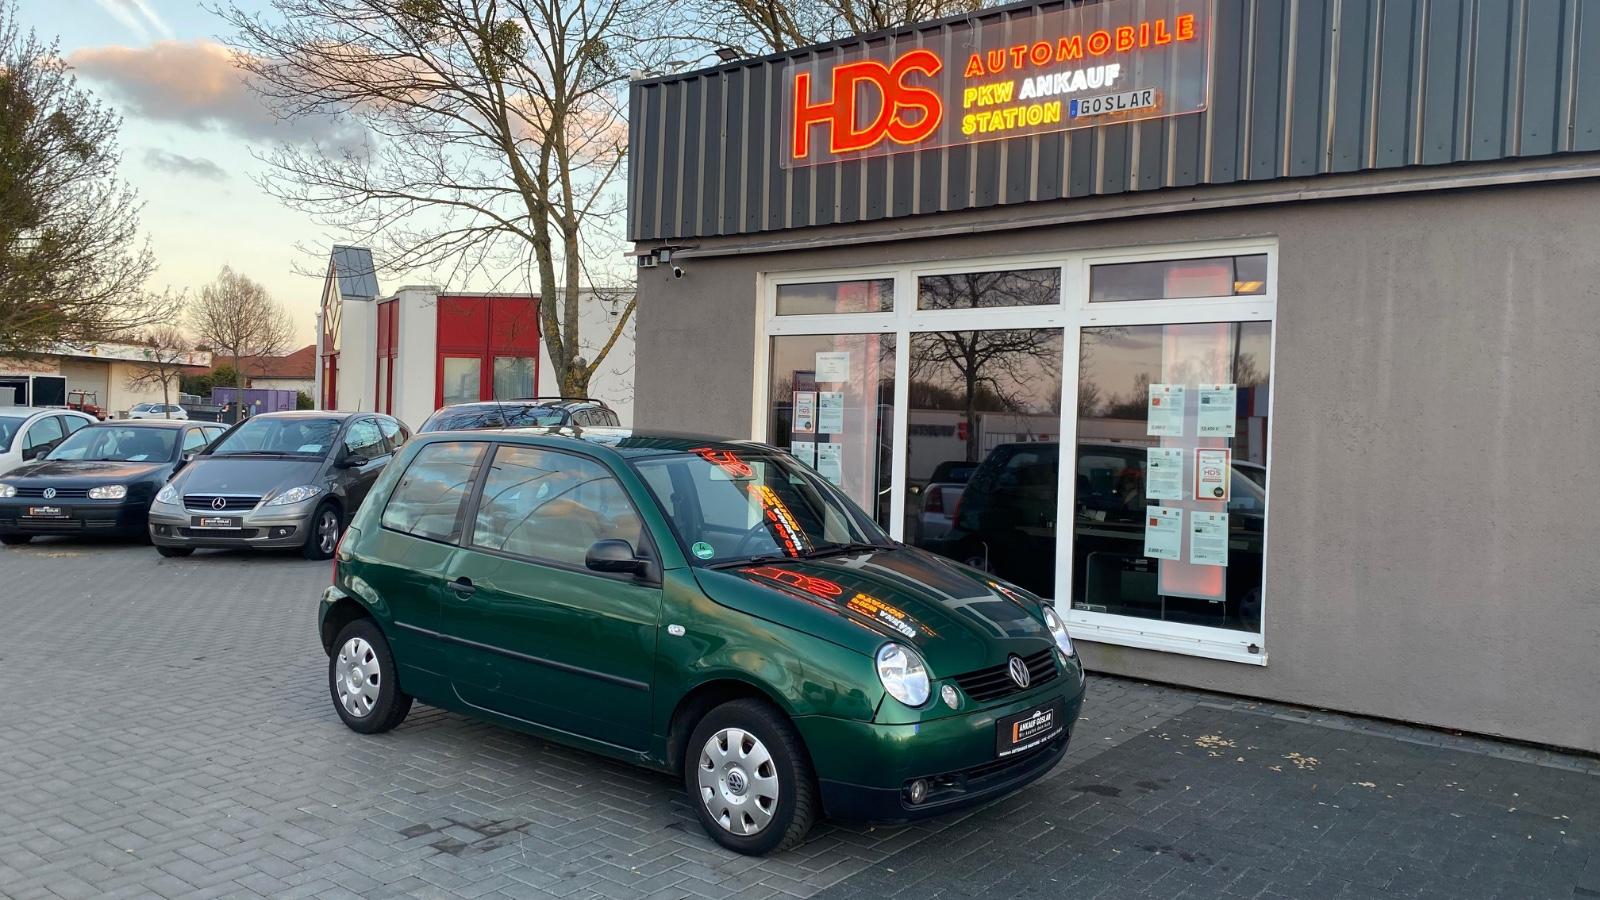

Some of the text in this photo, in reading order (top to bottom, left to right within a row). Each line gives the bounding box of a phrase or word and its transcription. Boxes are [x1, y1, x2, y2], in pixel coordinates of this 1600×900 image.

[964, 14, 1195, 78] AUTOMOBILE
[793, 49, 943, 158] HDS
[963, 63, 1120, 108] PKW ANKAUF
[1081, 90, 1151, 114] GOSLAR
[961, 101, 1061, 135] STATION
